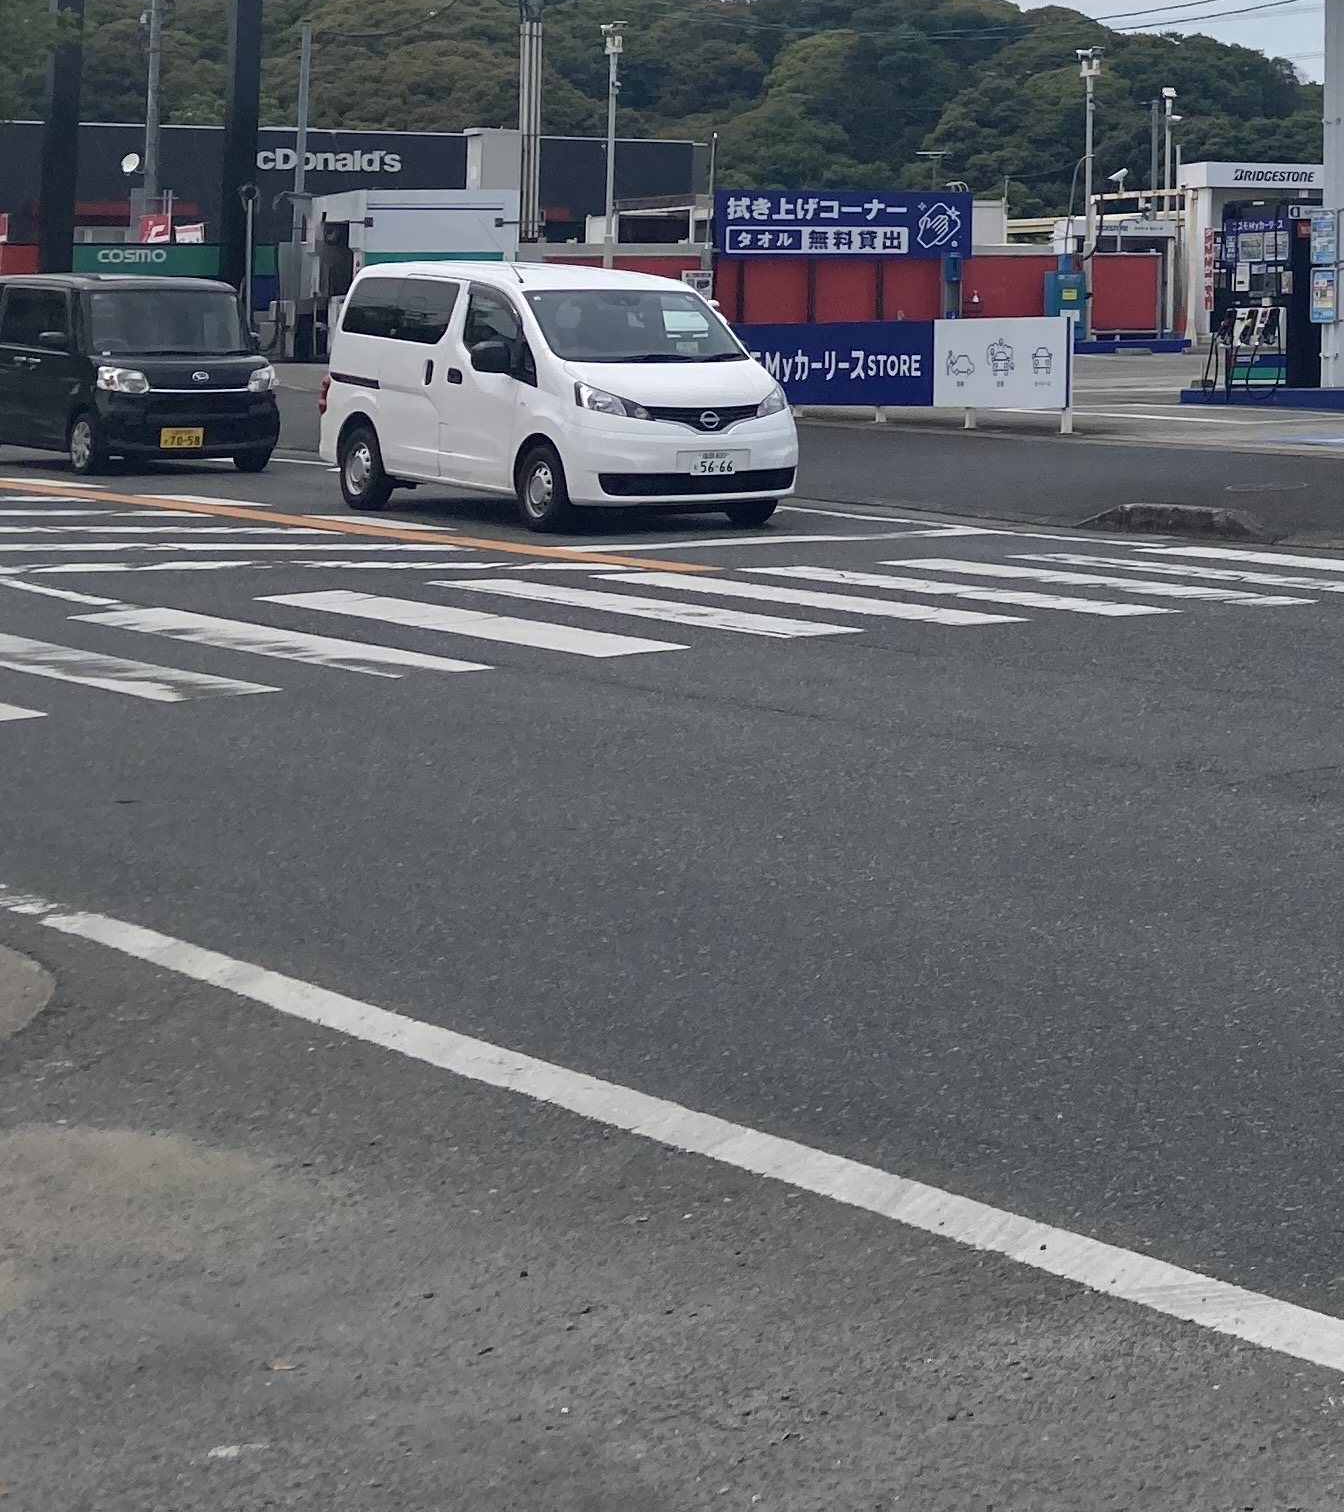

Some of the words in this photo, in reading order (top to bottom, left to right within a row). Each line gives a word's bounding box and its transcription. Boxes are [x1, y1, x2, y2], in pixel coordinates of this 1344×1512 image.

[256, 148, 401, 174] cDonald's
[1233, 169, 1315, 183] BRIDGESTONE
[727, 197, 908, 220] 拭き上げコーナー
[737, 232, 793, 248] タオル
[808, 230, 902, 250] 無料貸出
[97, 248, 167, 264] COSMO
[700, 460, 733, 473] 56-66
